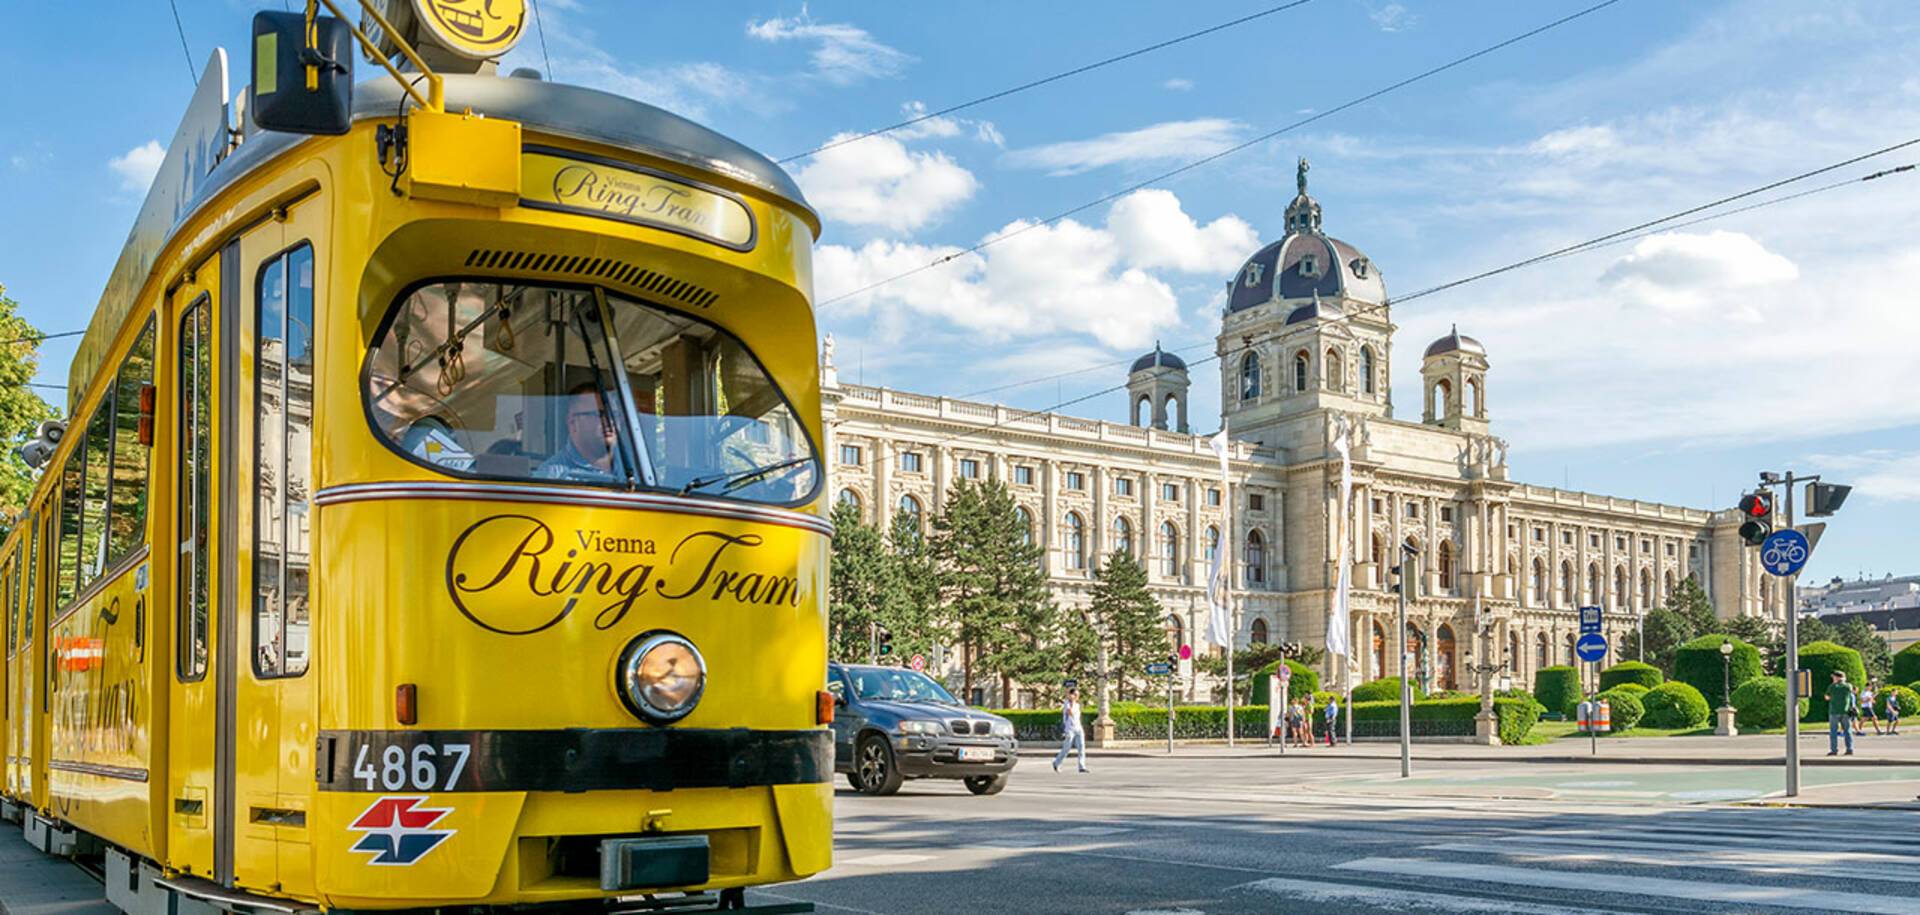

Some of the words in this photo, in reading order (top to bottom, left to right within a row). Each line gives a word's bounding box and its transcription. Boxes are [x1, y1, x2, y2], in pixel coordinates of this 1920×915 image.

[553, 164, 639, 216] Ring
[576, 529, 656, 554] Vienna
[445, 514, 654, 635] Ring
[656, 531, 803, 608] Tram
[353, 743, 471, 791] 4867
